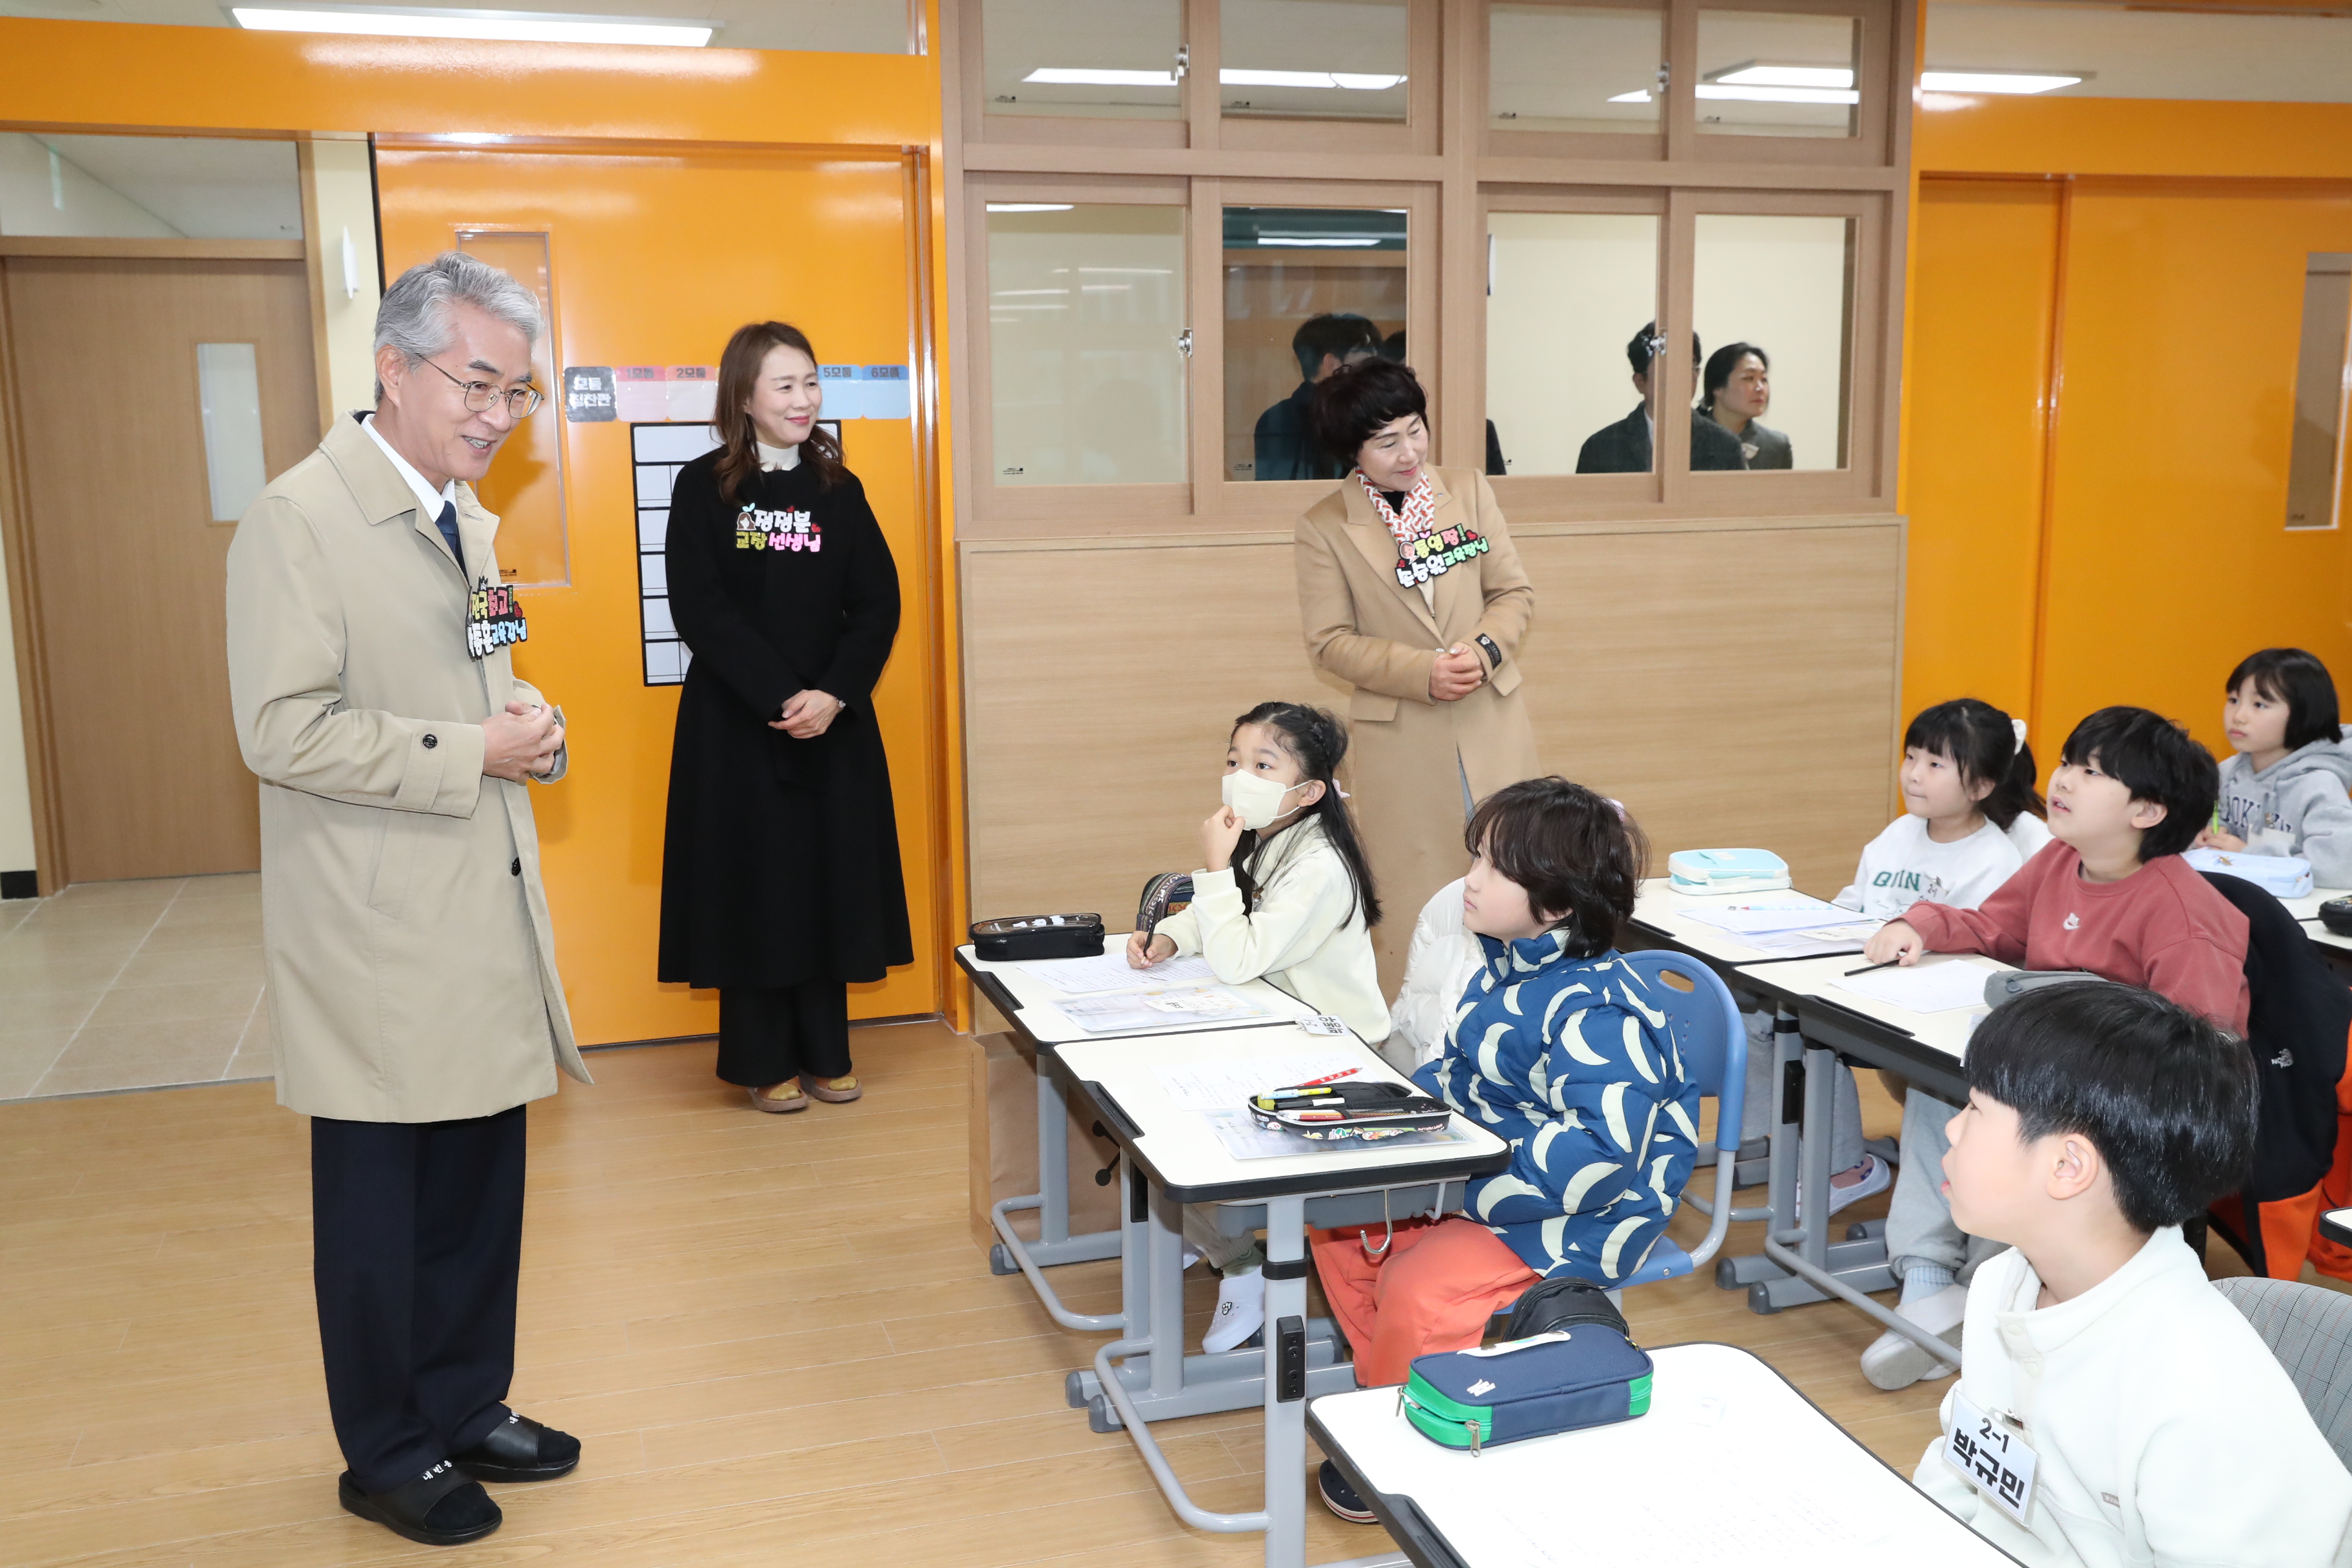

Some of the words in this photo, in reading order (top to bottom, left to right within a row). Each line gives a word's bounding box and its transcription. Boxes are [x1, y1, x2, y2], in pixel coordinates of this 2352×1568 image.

[754, 509, 811, 534] 정정분
[736, 531, 768, 550] 교장
[768, 532, 821, 553] 선생님
[1396, 554, 1447, 588] 손승원
[1442, 537, 1489, 567] 교육장님
[471, 591, 489, 620] 전국
[487, 587, 513, 617] 최고!
[491, 619, 527, 645] 교육감님
[1978, 1417, 2010, 1454] 2-1
[1952, 1427, 2025, 1509] 박규민
